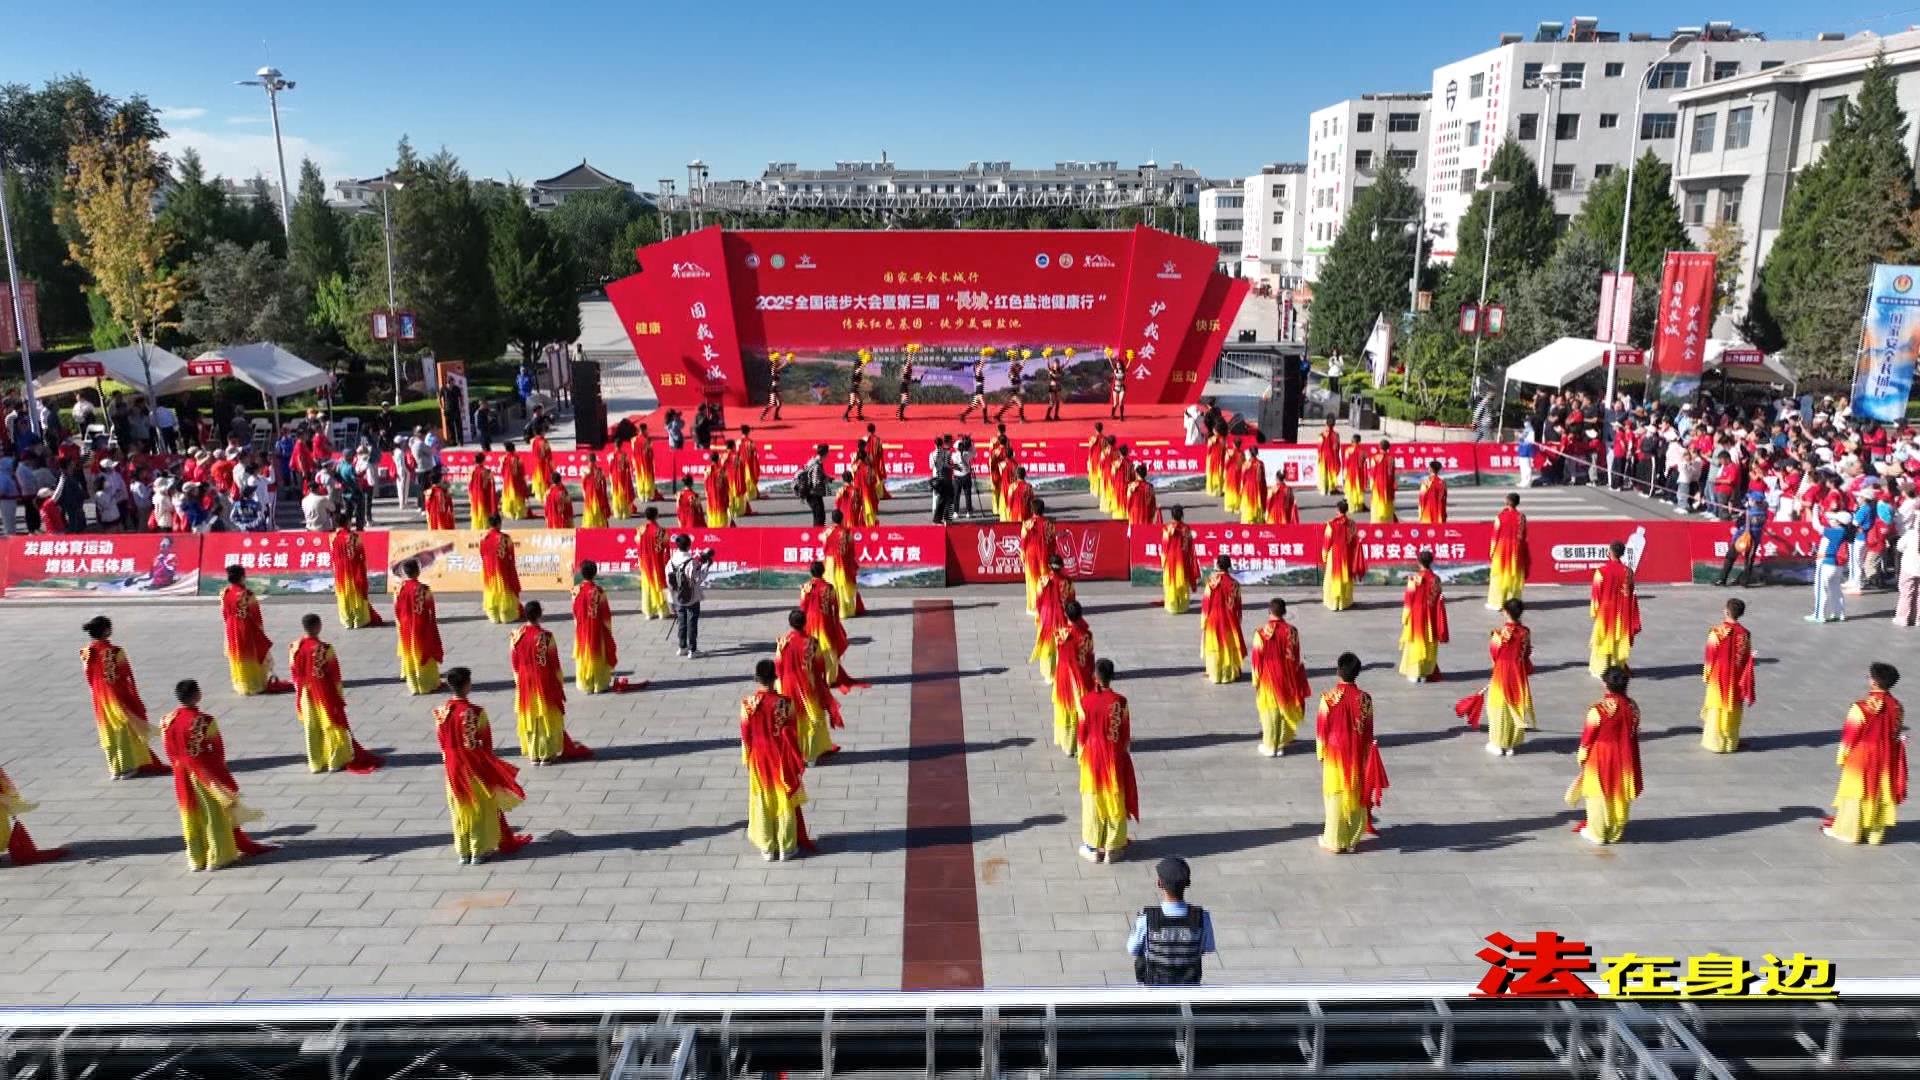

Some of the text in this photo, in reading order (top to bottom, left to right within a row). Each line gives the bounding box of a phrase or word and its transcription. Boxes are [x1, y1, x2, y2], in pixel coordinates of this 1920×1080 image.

[884, 271, 979, 284] 国家安全长城行
[635, 322, 662, 336] 健康
[1195, 319, 1221, 332] 快乐
[1132, 300, 1167, 380] 护我安全
[660, 374, 687, 386] 运动
[1172, 370, 1198, 383] 运动
[24, 540, 114, 556] 发展体育运动
[858, 546, 921, 562] 人人有责
[45, 557, 135, 573] 增强人民体质
